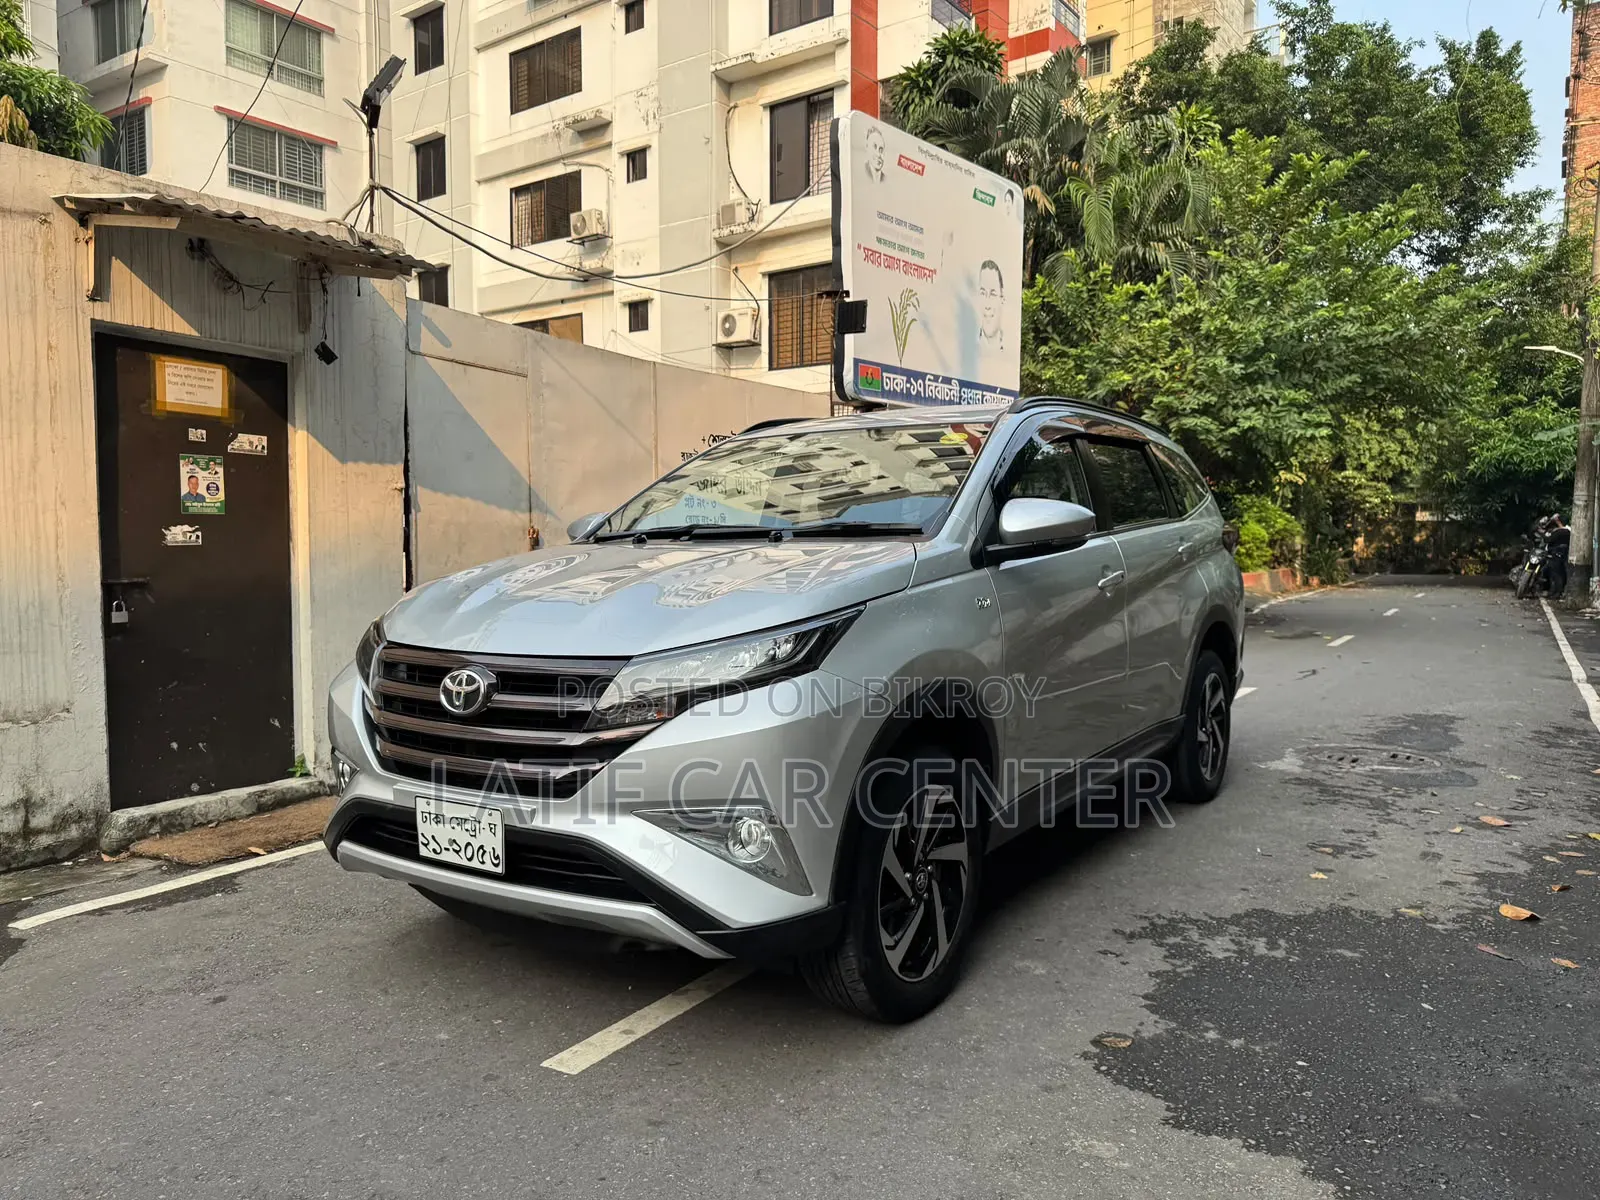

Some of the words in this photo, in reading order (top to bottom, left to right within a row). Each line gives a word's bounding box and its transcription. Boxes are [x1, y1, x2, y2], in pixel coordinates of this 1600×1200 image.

[899, 156, 923, 175] বাংলাদেশ
[876, 210, 894, 224] আমার
[894, 217, 908, 229] আগে
[876, 236, 897, 250] ক্ষমতার
[896, 243, 910, 254] আগে
[910, 247, 925, 260] জনতা
[882, 253, 901, 274] আগে
[882, 371, 924, 396] ঢাকা-১৭
[925, 373, 960, 403] নির্বাচনী
[961, 388, 982, 405] প্রধান
[420, 810, 446, 828] ঢাকা
[420, 832, 501, 868] ২১-২০৫৬
